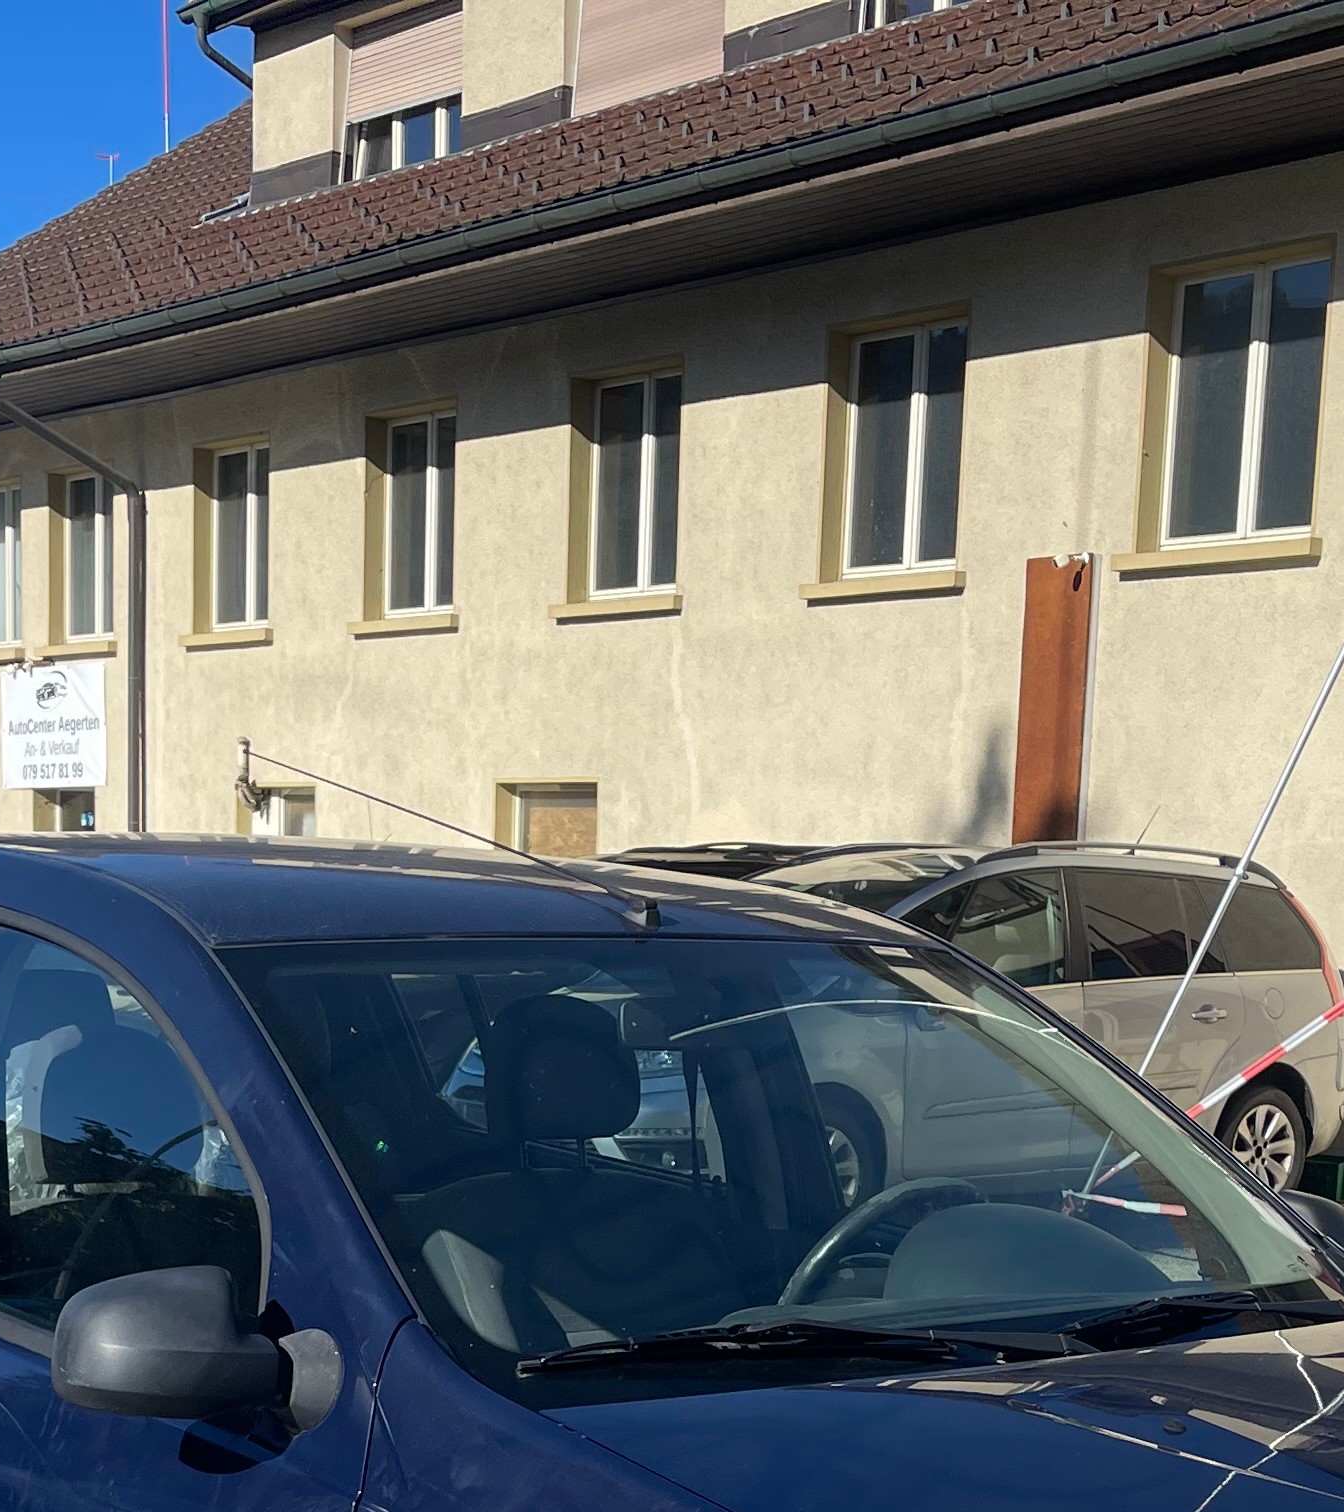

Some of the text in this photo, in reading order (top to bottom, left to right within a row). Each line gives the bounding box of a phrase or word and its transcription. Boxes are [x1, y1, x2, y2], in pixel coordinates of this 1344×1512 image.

[8, 715, 100, 736] AutoCenter Aegerten
[40, 740, 47, 756] &
[48, 737, 80, 755] Verkauf
[22, 761, 83, 780] 079 517 81 99
